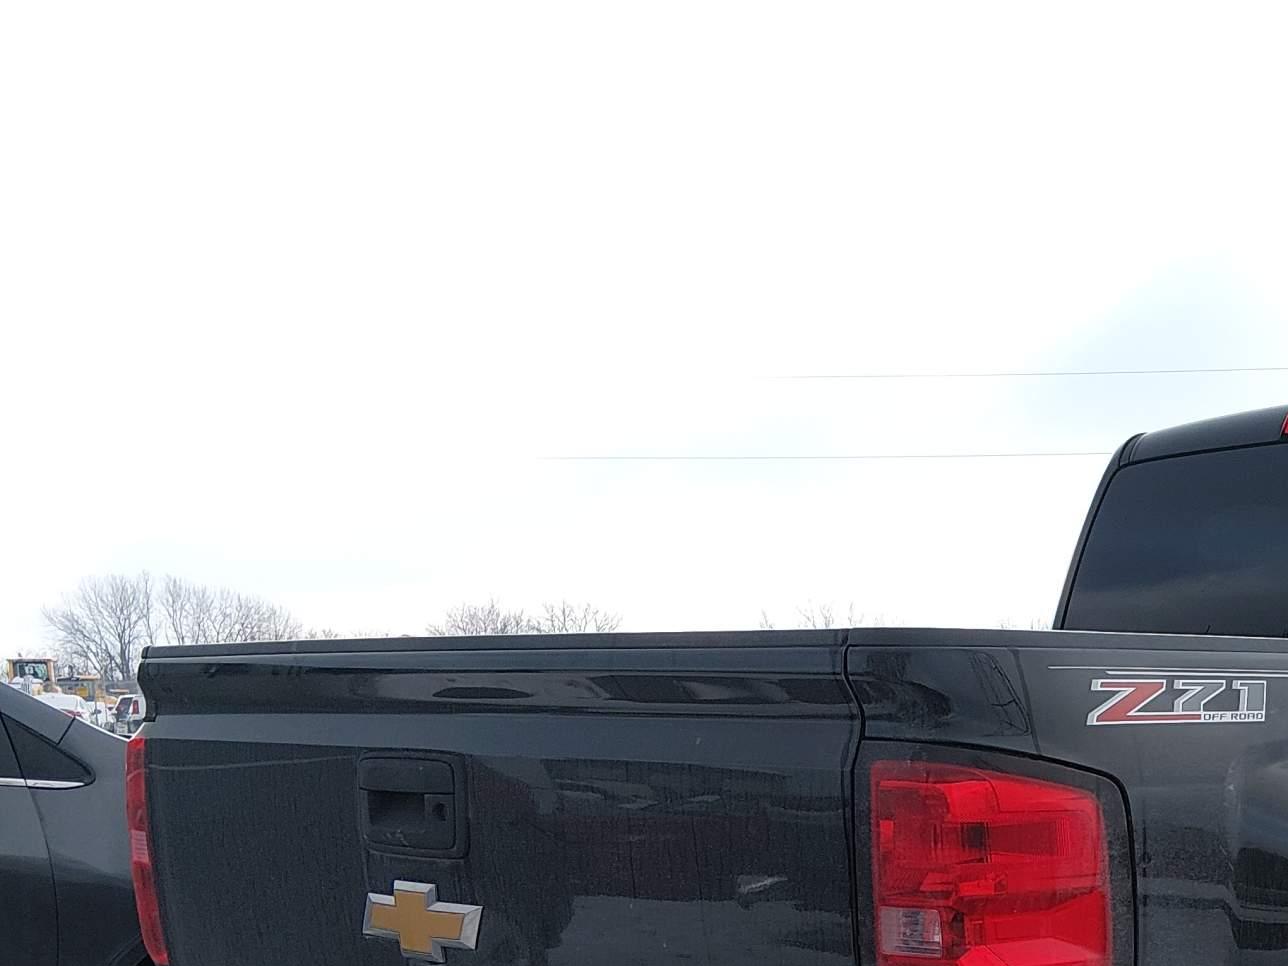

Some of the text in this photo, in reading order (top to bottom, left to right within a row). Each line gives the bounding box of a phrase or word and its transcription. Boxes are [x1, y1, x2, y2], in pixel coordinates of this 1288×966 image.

[1086, 679, 1267, 726] Z71
[1203, 712, 1264, 721] OFF ROAD
